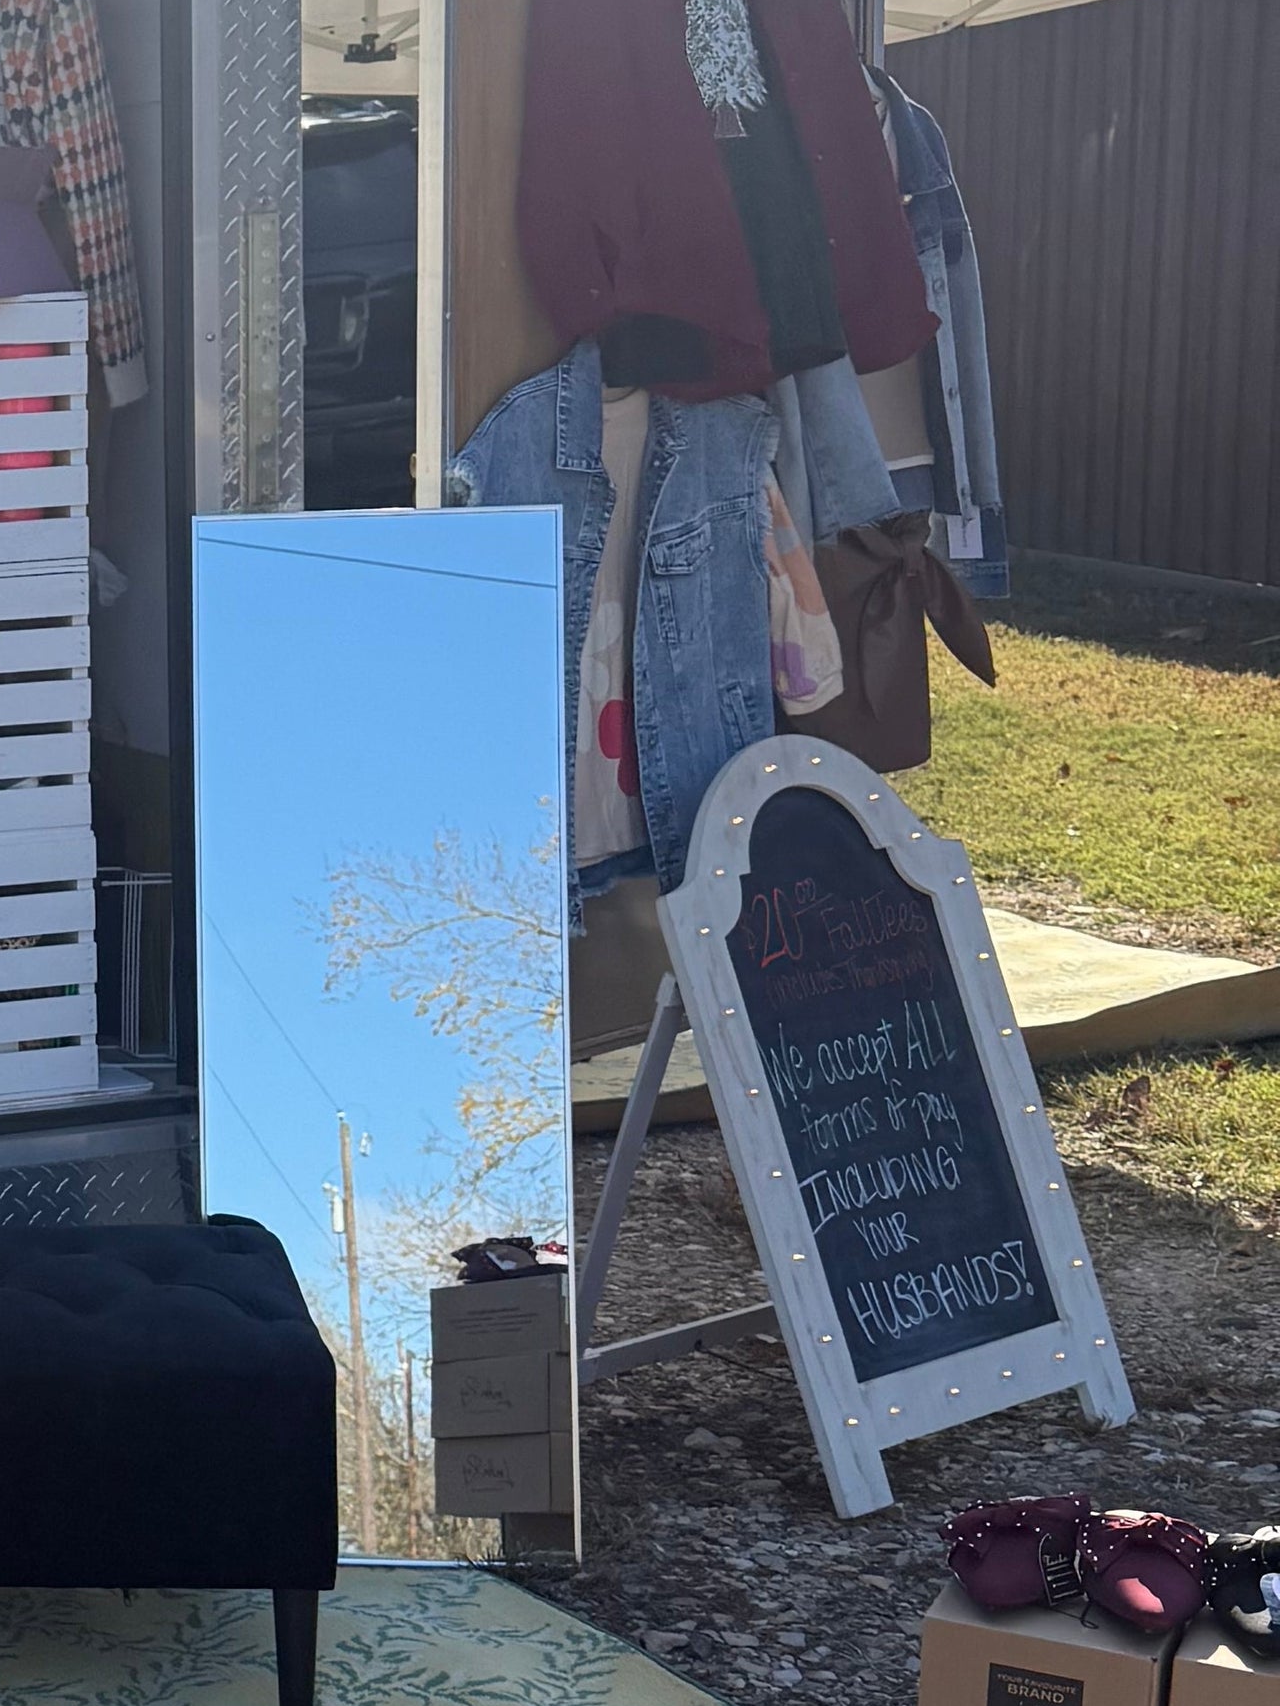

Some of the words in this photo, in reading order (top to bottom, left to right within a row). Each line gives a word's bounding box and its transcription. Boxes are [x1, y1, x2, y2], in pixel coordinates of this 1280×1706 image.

[756, 1022, 814, 1109] We
[817, 1019, 898, 1085] accept
[904, 999, 958, 1071] ALL
[800, 1096, 878, 1155] forms
[884, 1077, 907, 1132] of
[911, 1090, 965, 1153] pay
[797, 1145, 963, 1236] INCLUDING
[852, 1211, 921, 1262] YOUR
[846, 1239, 1036, 1346] HUSBANDS!
[1007, 1683, 1065, 1704] BRAND
